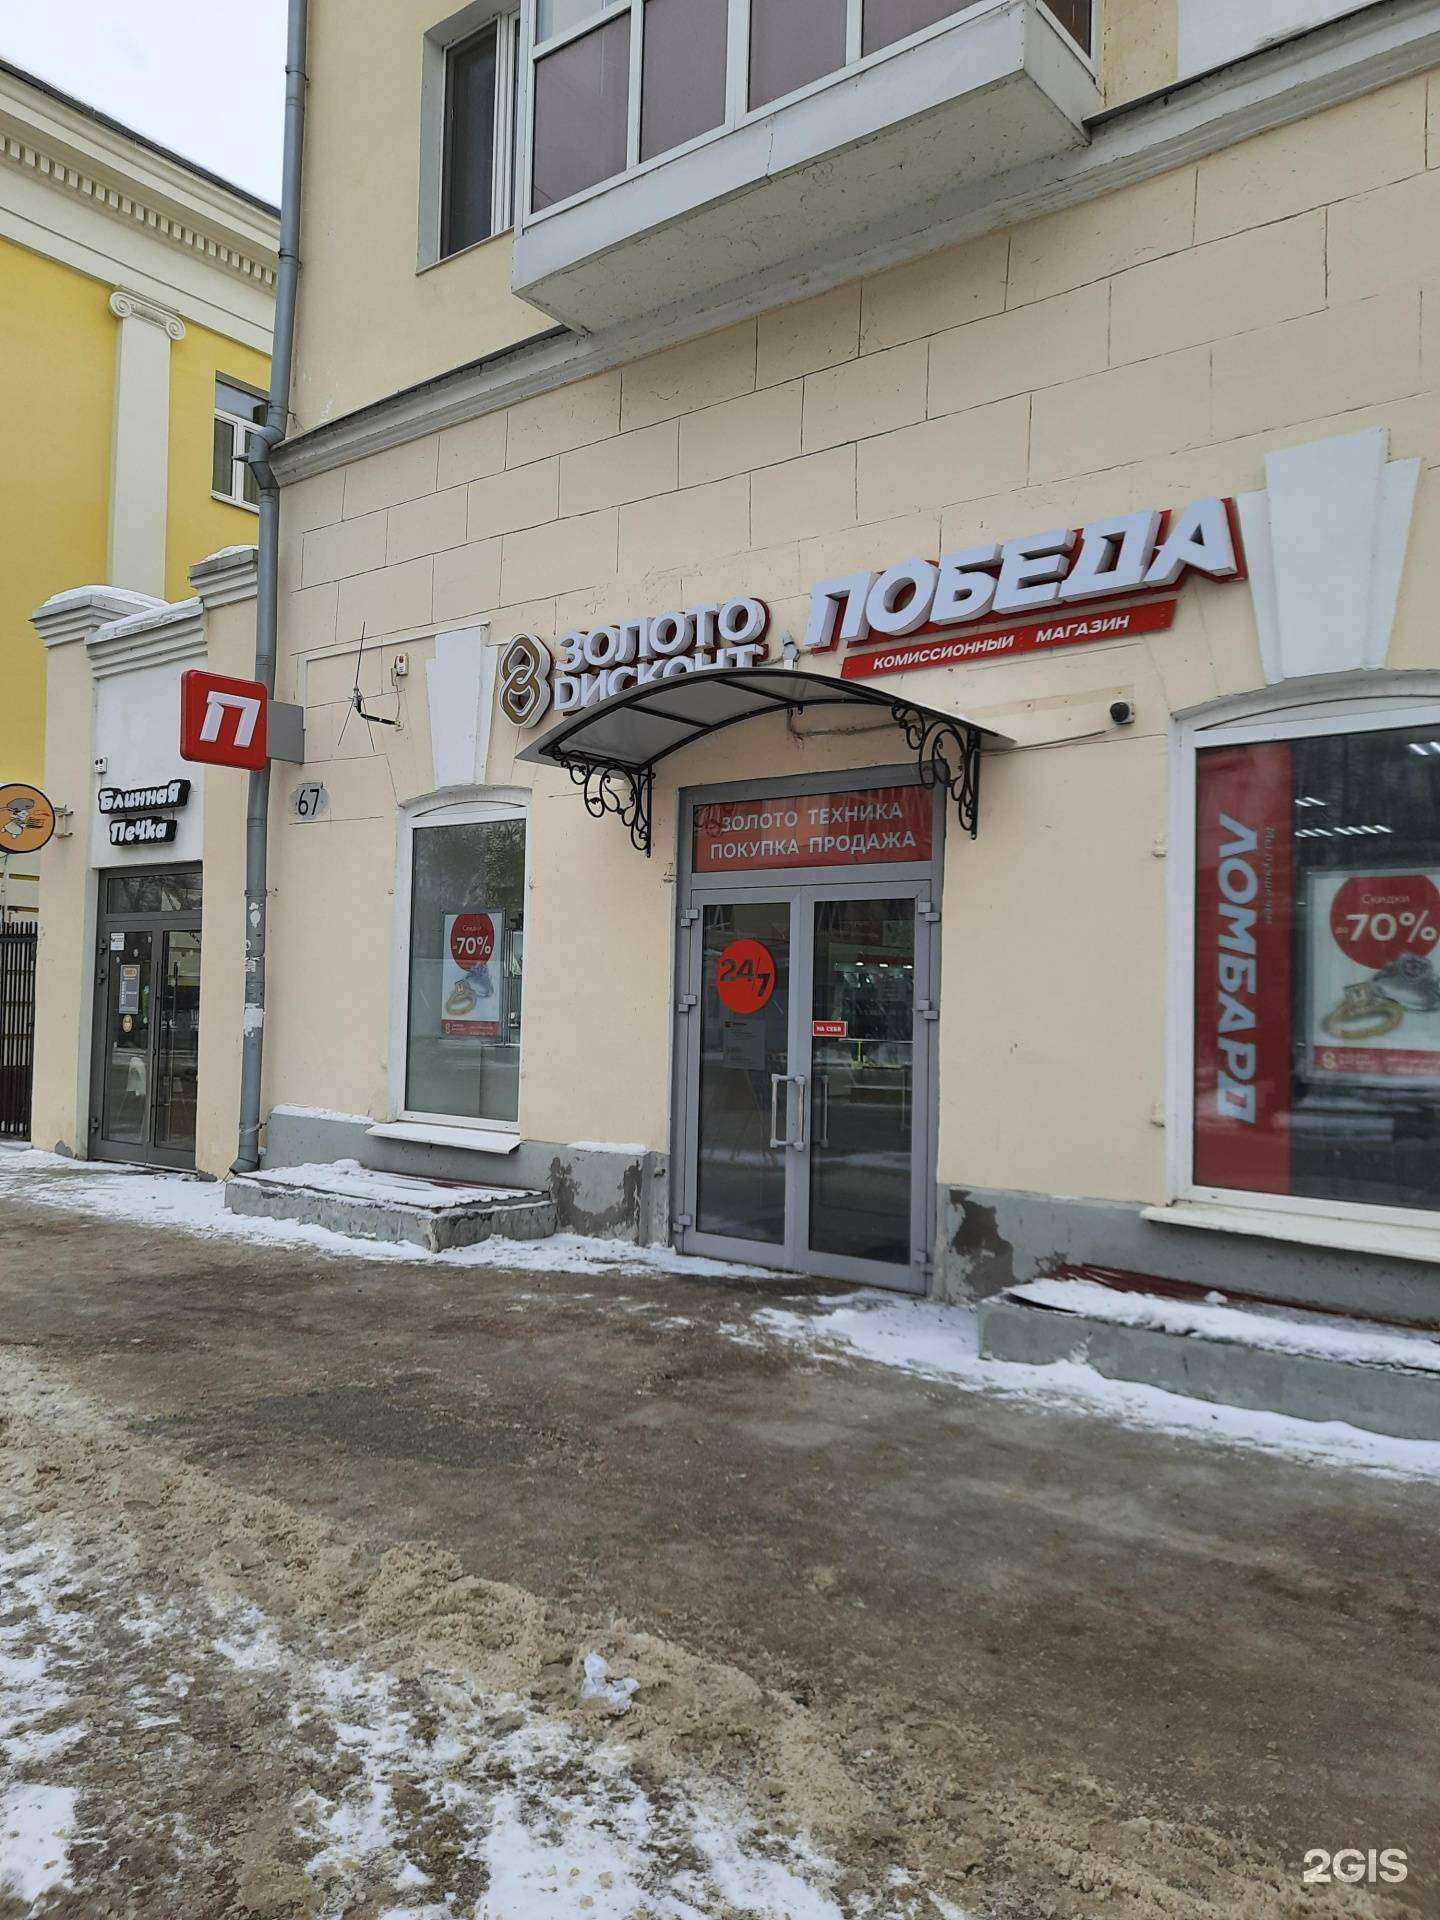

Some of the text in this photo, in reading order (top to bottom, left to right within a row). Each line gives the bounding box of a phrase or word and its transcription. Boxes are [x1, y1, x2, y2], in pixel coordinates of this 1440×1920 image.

[803, 496, 1239, 648] ПОБЕДА
[555, 597, 769, 673] ЗОЛОТО
[1035, 614, 1130, 643] МАГАЗИН
[200, 691, 261, 748] П
[298, 789, 320, 816] 67
[722, 803, 903, 832] ЗОЛОТО ТЕХНИКА
[710, 830, 916, 860] ПОКУПКА ПРОДАЖА
[1345, 910, 1438, 943] 70%
[456, 935, 491, 955] 70%
[1217, 810, 1258, 1124] ЛОМБАРД
